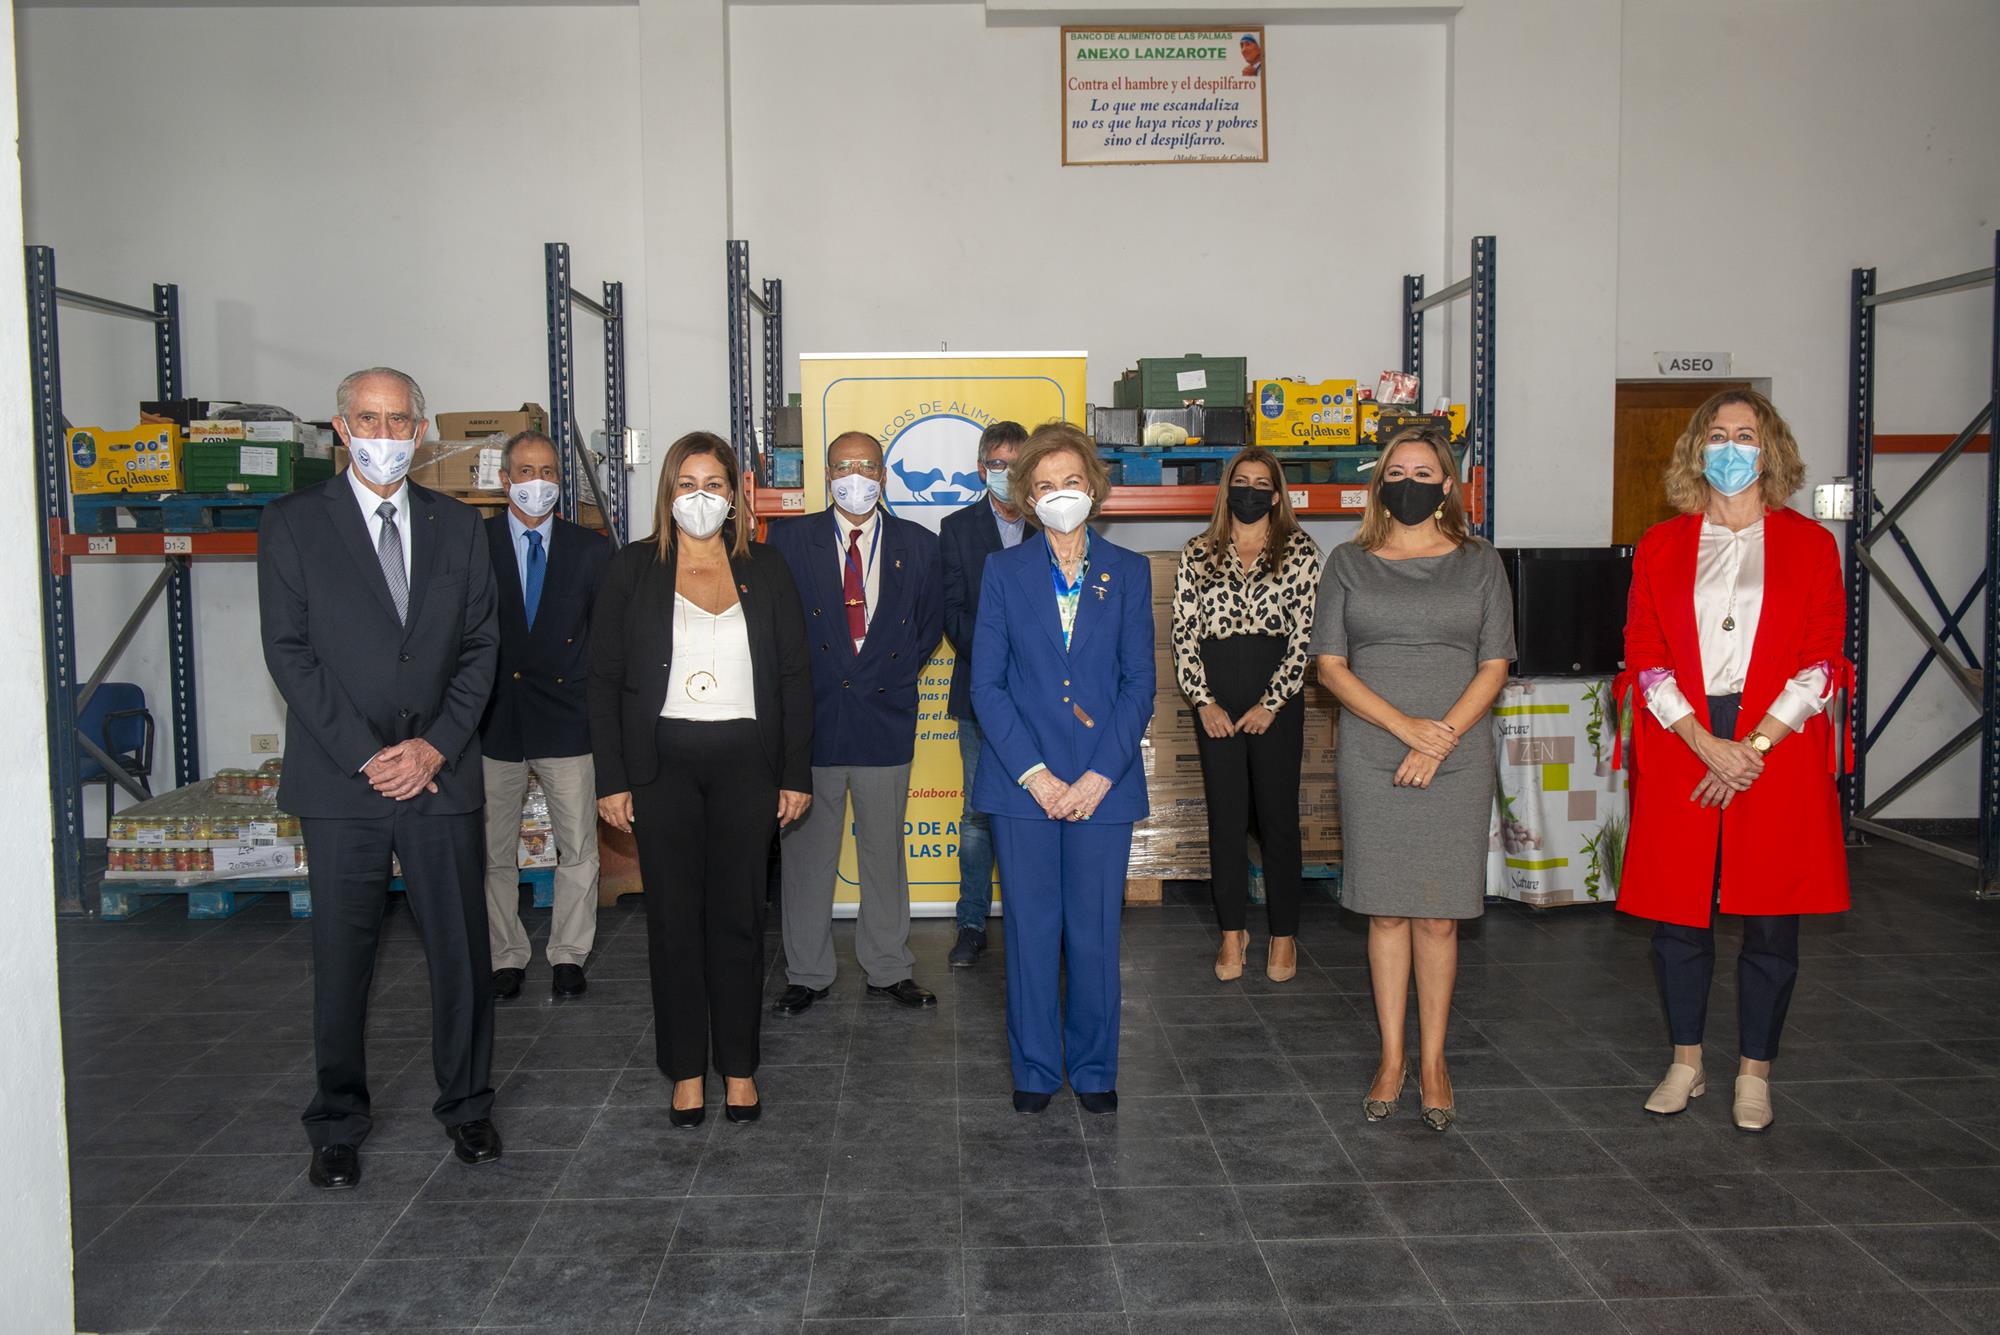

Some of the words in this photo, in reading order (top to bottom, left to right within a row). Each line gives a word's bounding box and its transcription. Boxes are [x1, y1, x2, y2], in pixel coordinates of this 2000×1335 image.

[1070, 32, 1102, 41] BANCO
[1104, 32, 1116, 41] DE
[1117, 32, 1162, 41] ALIMENTO
[1163, 32, 1176, 41] DE
[1178, 32, 1196, 41] LAS
[1197, 32, 1233, 41] PALMAS
[1077, 47, 1130, 59] ANEXO
[1135, 47, 1227, 59] LANZAROTE
[1068, 76, 1109, 91] Contra
[1111, 76, 1122, 91] el
[1125, 76, 1168, 91] hambre
[1171, 80, 1178, 94] y
[1180, 76, 1191, 91] el
[1194, 76, 1256, 94] despilfarro
[1090, 98, 1109, 112] Lo
[1112, 102, 1136, 115] que
[1140, 102, 1159, 111] me
[1163, 98, 1239, 111] escandaliza
[1072, 119, 1088, 129] no
[1091, 119, 1104, 129] es
[1108, 119, 1131, 132] que
[1135, 115, 1167, 132] haya
[1171, 116, 1201, 129] ricos
[1205, 119, 1213, 132] y
[1216, 115, 1258, 133] pobres
[1104, 134, 1132, 146] sino
[1135, 133, 1147, 146] el
[1150, 132, 1226, 149] despilfarro.
[1669, 358, 1714, 372] ASEO
[879, 408, 916, 448] NCOS
[919, 400, 943, 415] DE
[783, 498, 803, 507] E1-1
[1342, 496, 1362, 505] E3-2
[924, 675, 935, 686] la
[920, 692, 939, 701] nas
[932, 711, 943, 721] el
[920, 730, 931, 740] el
[1497, 718, 1531, 738] Nature
[1520, 740, 1555, 762] ZEN
[918, 821, 941, 836] DE
[910, 844, 942, 858] LAS
[1511, 870, 1540, 890] Nature
